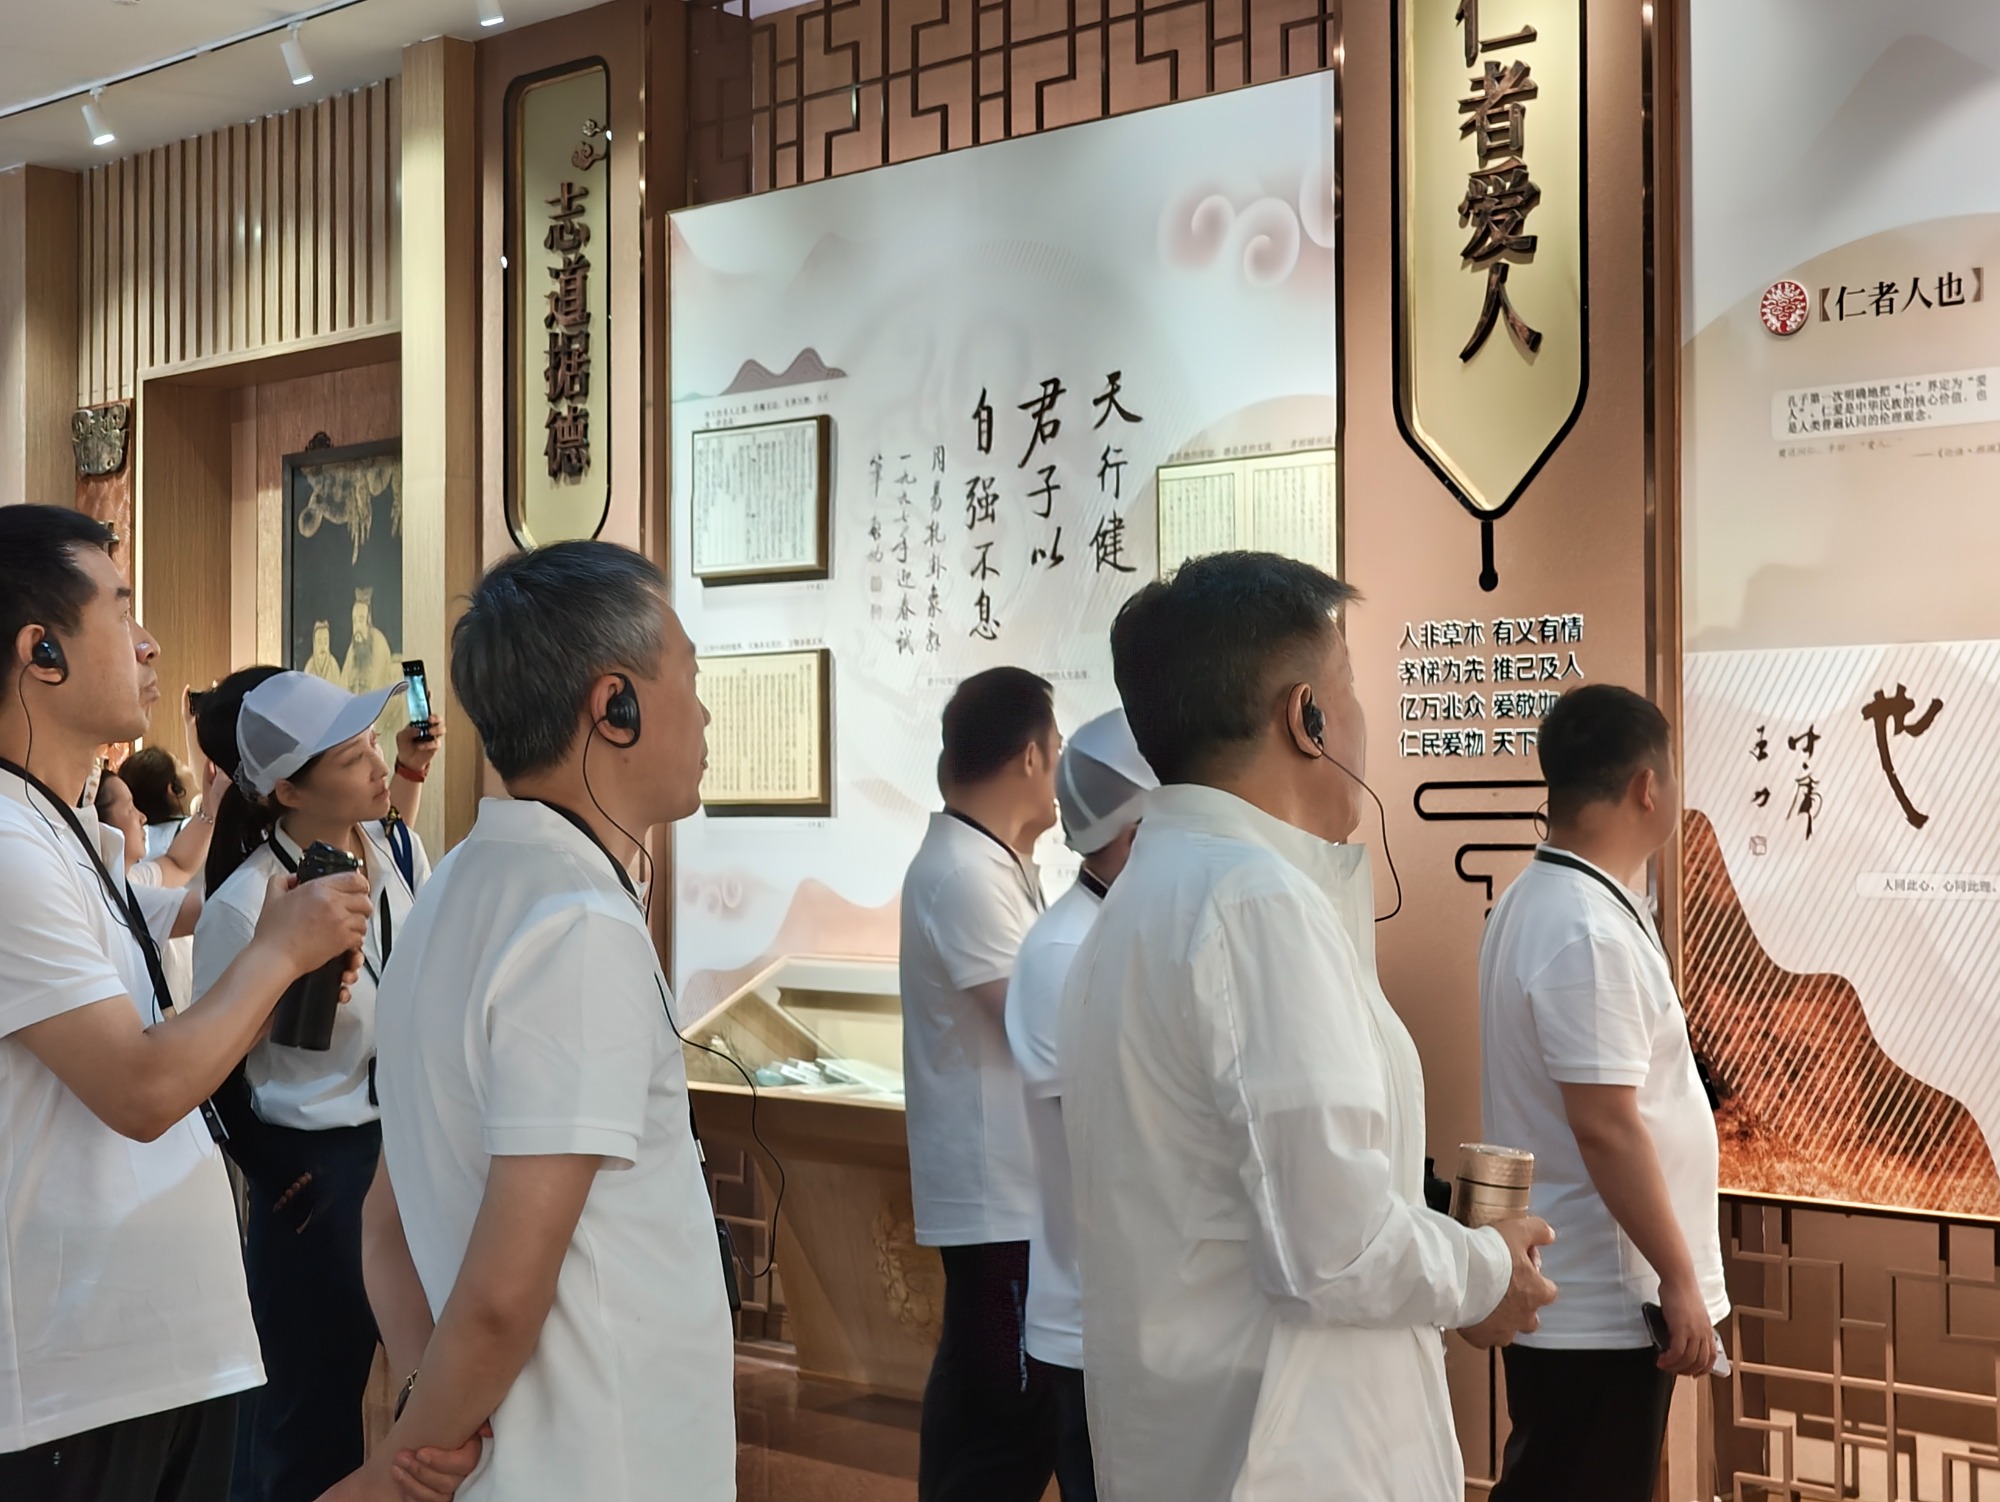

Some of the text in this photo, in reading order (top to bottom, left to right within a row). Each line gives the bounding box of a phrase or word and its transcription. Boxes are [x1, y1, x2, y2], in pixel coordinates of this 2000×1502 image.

[1456, 0, 1542, 363] 仁者爱人
[544, 181, 592, 482] 志道据德
[964, 387, 1001, 641] 自强不息
[1017, 377, 1067, 570] 君子以
[1089, 371, 1143, 574] 天行健
[1397, 613, 1584, 651] 人非草木 有义有情
[1398, 650, 1585, 687] 孝悌为先 推己及人
[1399, 690, 1486, 722] 亿万兆众
[1398, 728, 1486, 758] 仁民爱物
